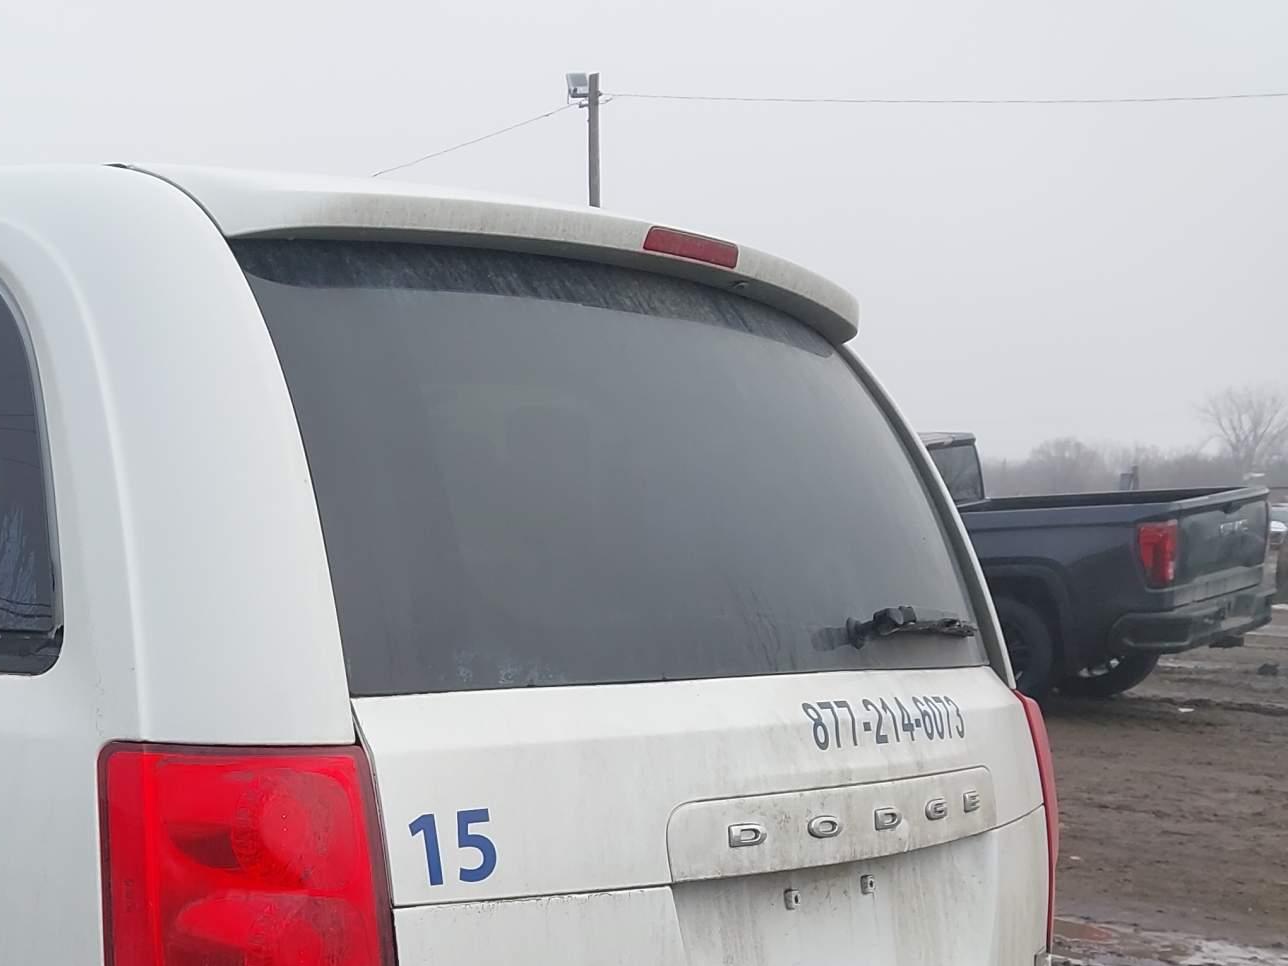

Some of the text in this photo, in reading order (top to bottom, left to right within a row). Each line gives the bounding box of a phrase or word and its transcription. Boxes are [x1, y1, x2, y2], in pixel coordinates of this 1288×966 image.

[801, 695, 965, 751] 877-214-6073
[408, 808, 497, 887] 15
[728, 789, 981, 848] DODGE
